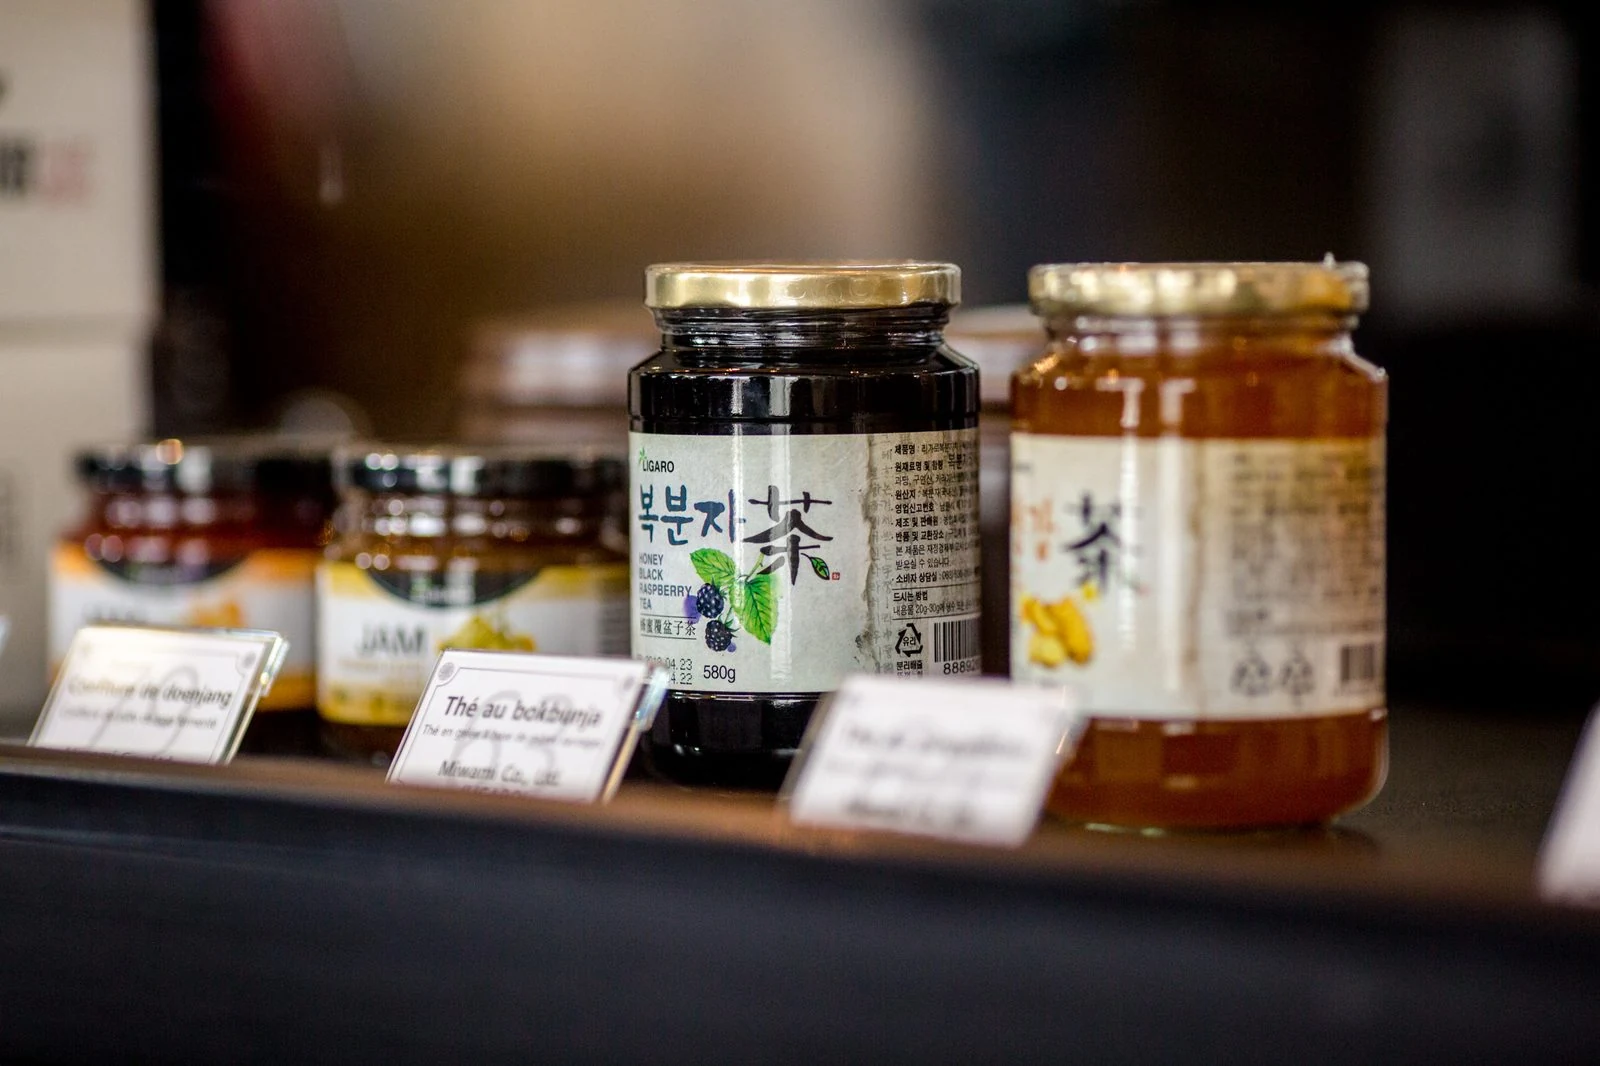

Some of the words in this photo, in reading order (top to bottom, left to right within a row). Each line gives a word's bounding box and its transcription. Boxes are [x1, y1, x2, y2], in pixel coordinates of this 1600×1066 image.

[895, 444, 915, 455] 제품명
[642, 459, 675, 473] LIGARO
[895, 489, 916, 501] 원산지
[895, 516, 910, 528] 제조
[638, 483, 747, 546] 복분자
[742, 484, 834, 586] 茶
[895, 531, 909, 543] 반품
[639, 552, 664, 566] HONEY
[896, 558, 917, 570] 받으실
[919, 558, 925, 569] 수
[639, 567, 664, 581] BLACK
[896, 572, 917, 584] 소비자
[919, 571, 938, 583] 상담실
[639, 582, 692, 597] RASPBERRY
[893, 590, 914, 602] 드시는
[640, 597, 652, 610] TEA
[902, 635, 916, 647] 유리
[703, 664, 736, 684] 580g
[444, 695, 478, 719] Thé
[481, 702, 507, 720] au
